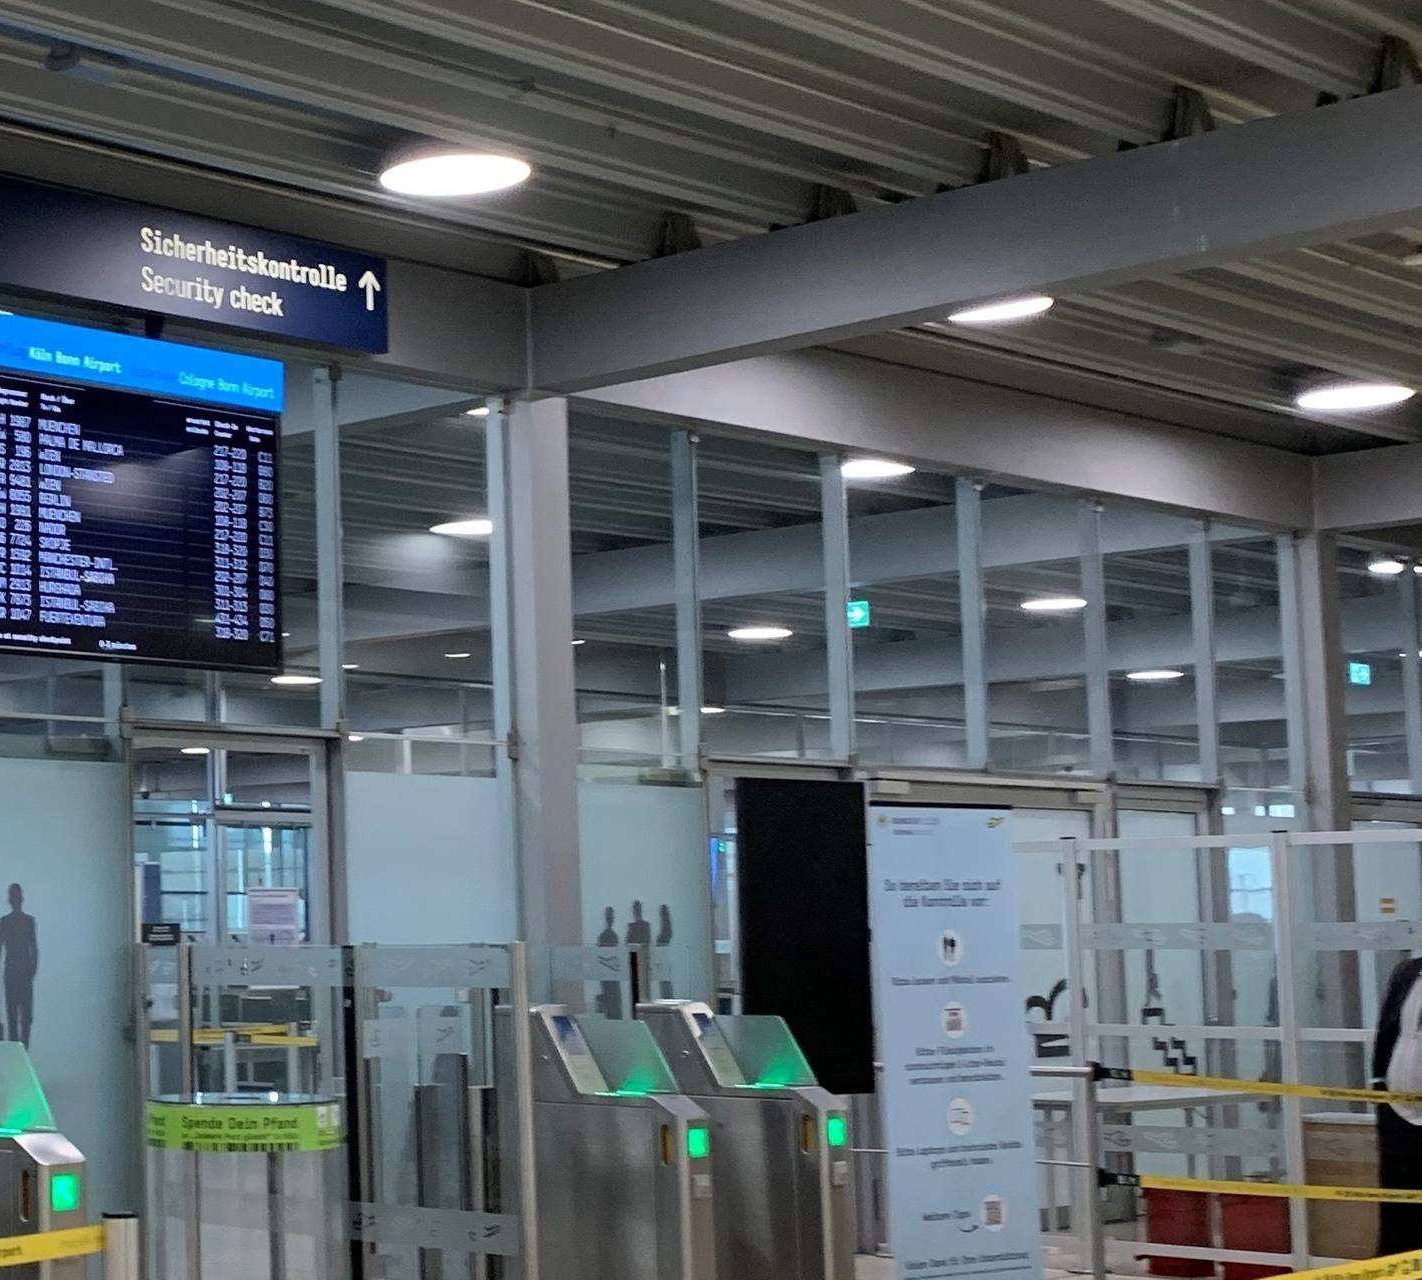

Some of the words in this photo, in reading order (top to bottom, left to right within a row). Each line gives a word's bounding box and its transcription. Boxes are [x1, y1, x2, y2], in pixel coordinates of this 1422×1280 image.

[140, 226, 347, 292] Sicherheitskontrolle
[141, 266, 224, 309] Security
[230, 285, 284, 317] check
[29, 346, 52, 363] Köln
[56, 351, 80, 366] Bonn
[83, 355, 123, 375] Airport
[179, 371, 216, 391] Cologne
[218, 377, 239, 393] Bonn
[242, 381, 276, 400] Airport
[181, 1115, 224, 1130] Spende
[227, 1116, 258, 1130] Dein
[263, 1115, 299, 1129] Pfand
